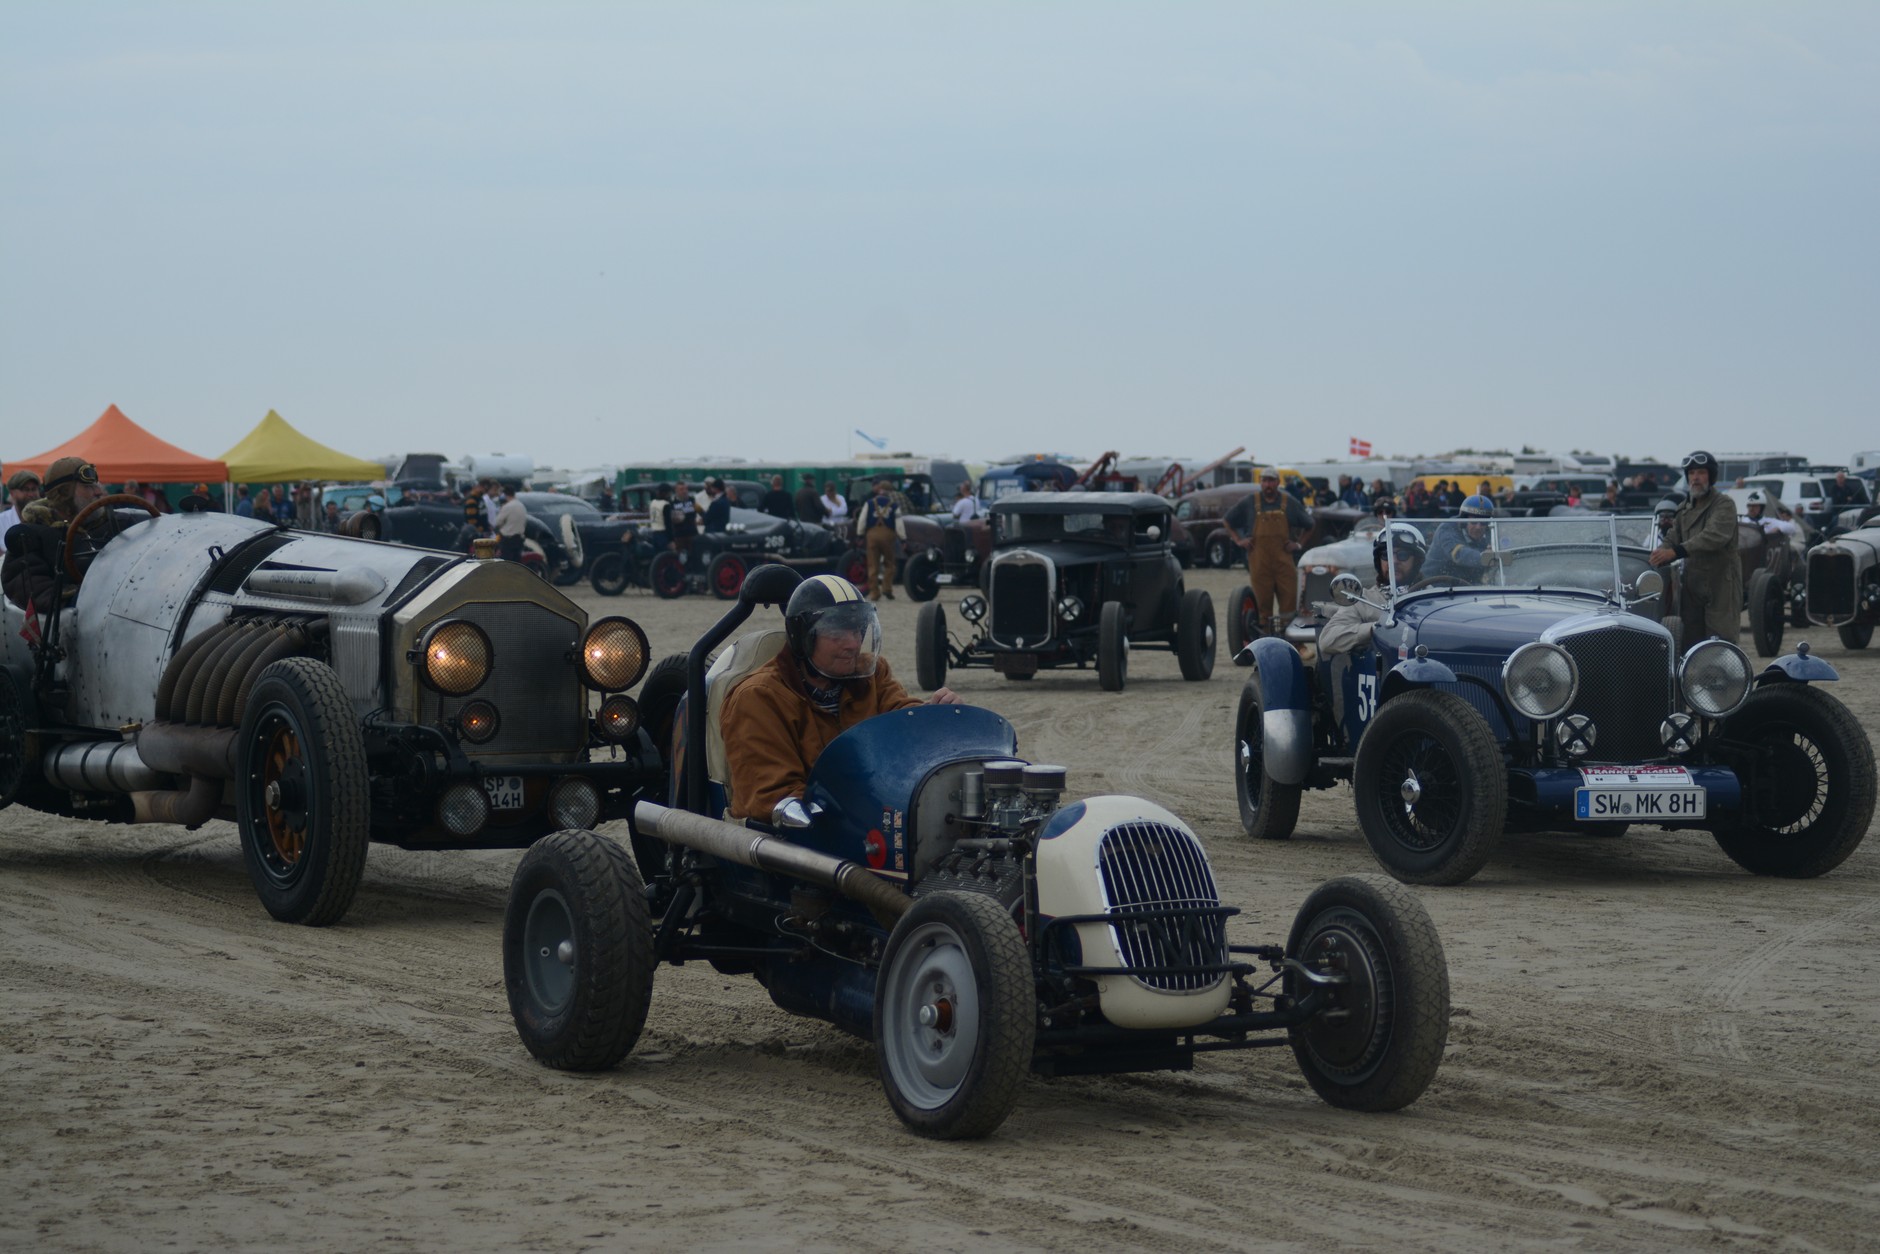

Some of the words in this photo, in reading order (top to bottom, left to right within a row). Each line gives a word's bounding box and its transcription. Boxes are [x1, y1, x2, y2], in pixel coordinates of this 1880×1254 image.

[1358, 673, 1377, 722] 57
[486, 778, 505, 791] SP
[1594, 794, 1622, 814] SW
[1636, 793, 1662, 814] MK
[1669, 793, 1696, 814] 8H
